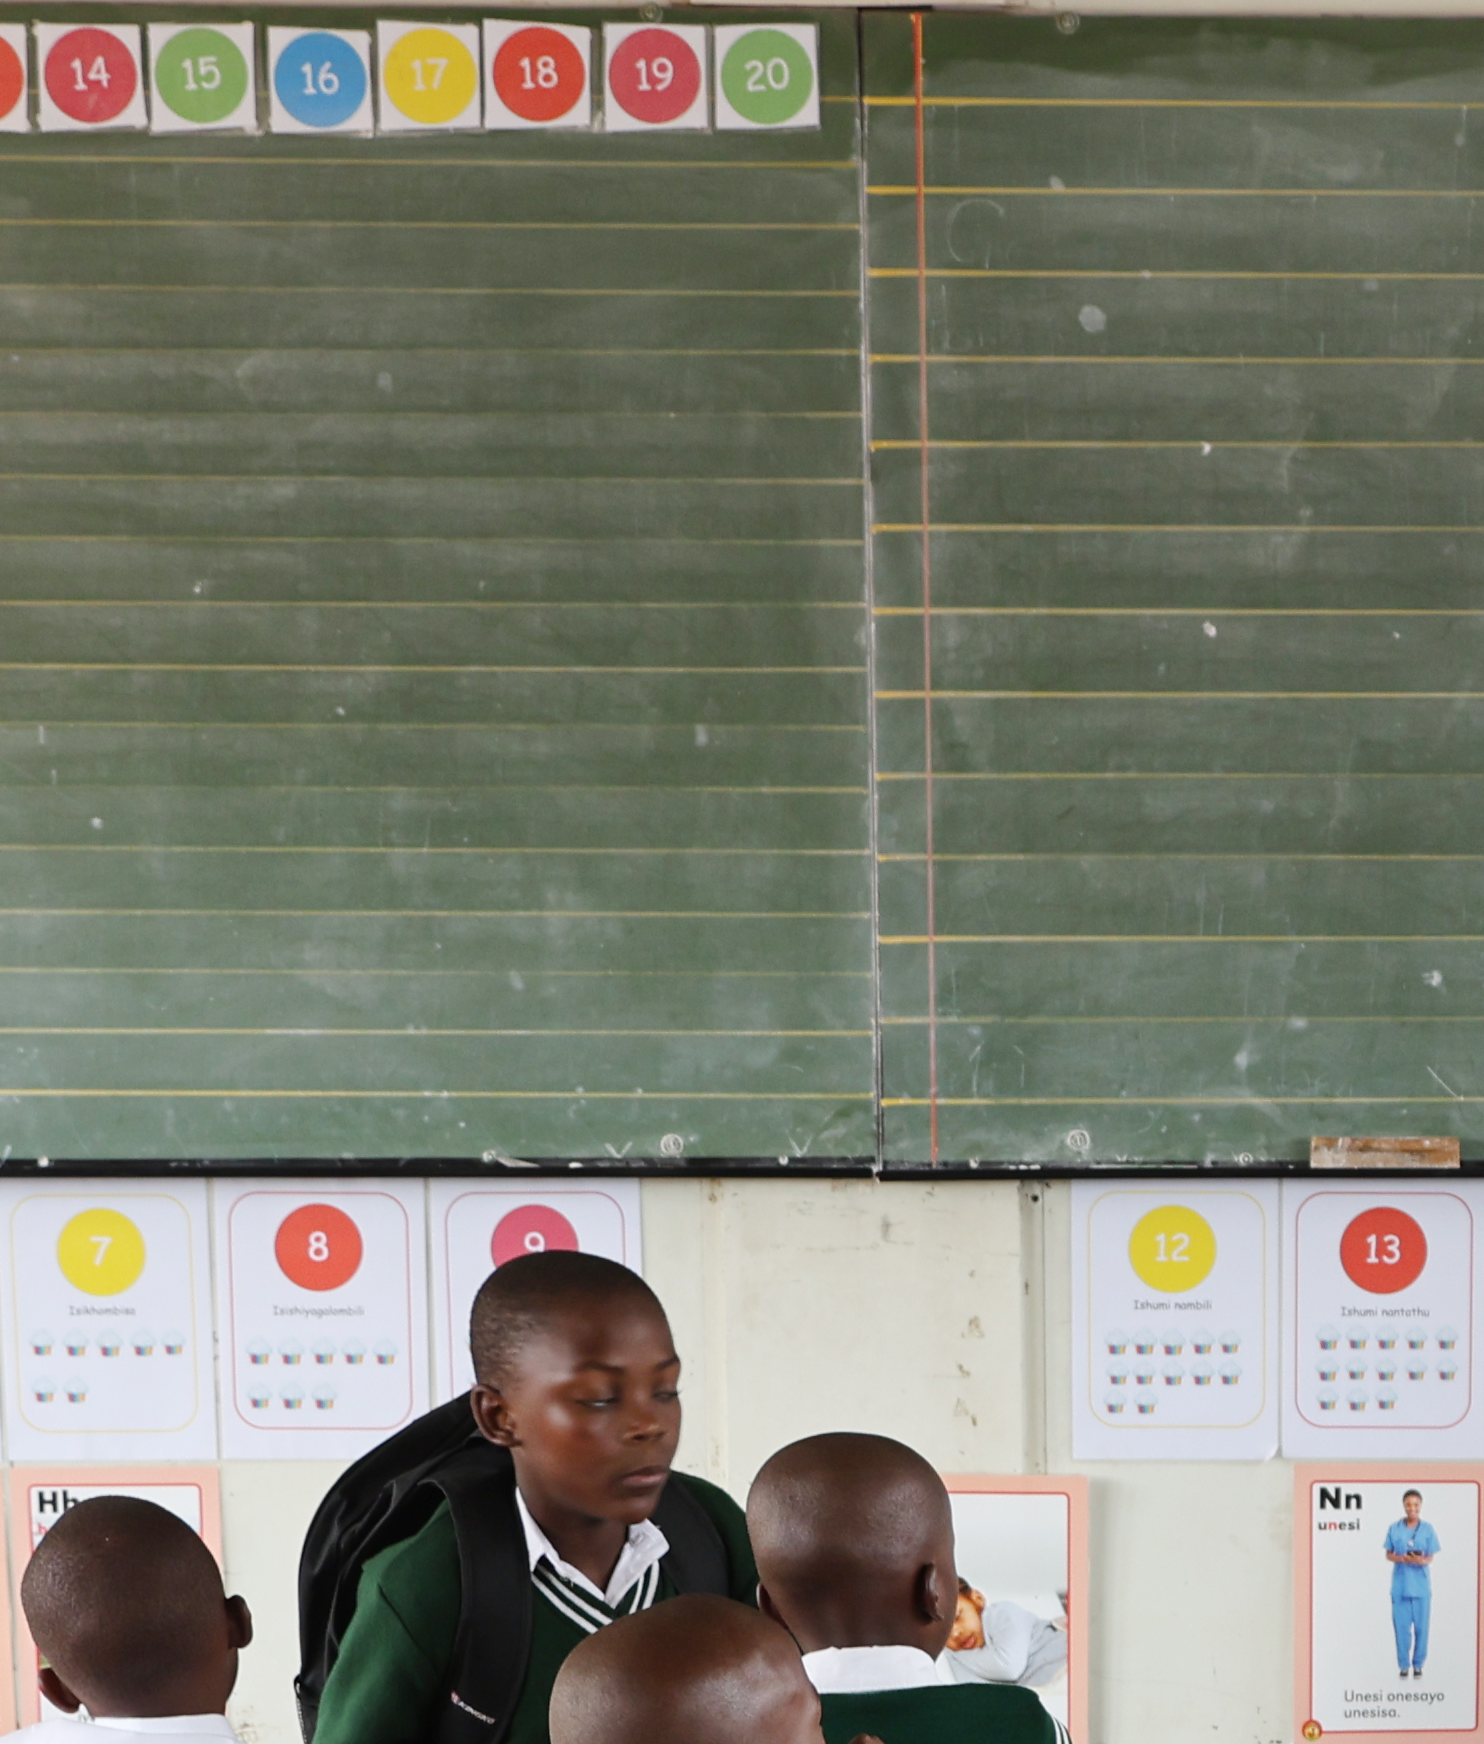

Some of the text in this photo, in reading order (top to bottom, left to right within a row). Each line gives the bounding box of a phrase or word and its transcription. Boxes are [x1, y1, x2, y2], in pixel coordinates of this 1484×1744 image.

[70, 56, 111, 90] 14
[181, 56, 221, 90] 15
[301, 62, 340, 95] 16
[411, 57, 449, 90] 17
[519, 55, 558, 89] 18
[635, 56, 674, 91] 19
[745, 57, 790, 92] 20
[89, 1236, 113, 1266] 7
[308, 1231, 330, 1262] 8
[1155, 1233, 1191, 1262] 12
[1364, 1234, 1401, 1264] 13
[1134, 1299, 1212, 1311] Ishumi nambili
[1341, 1306, 1430, 1318] Ishumi nantathu
[1319, 1487, 1362, 1510] Nn
[1318, 1519, 1360, 1531] unesi
[1344, 1690, 1445, 1707] Unesi onesayo
[1344, 1706, 1400, 1719] unesisa.
